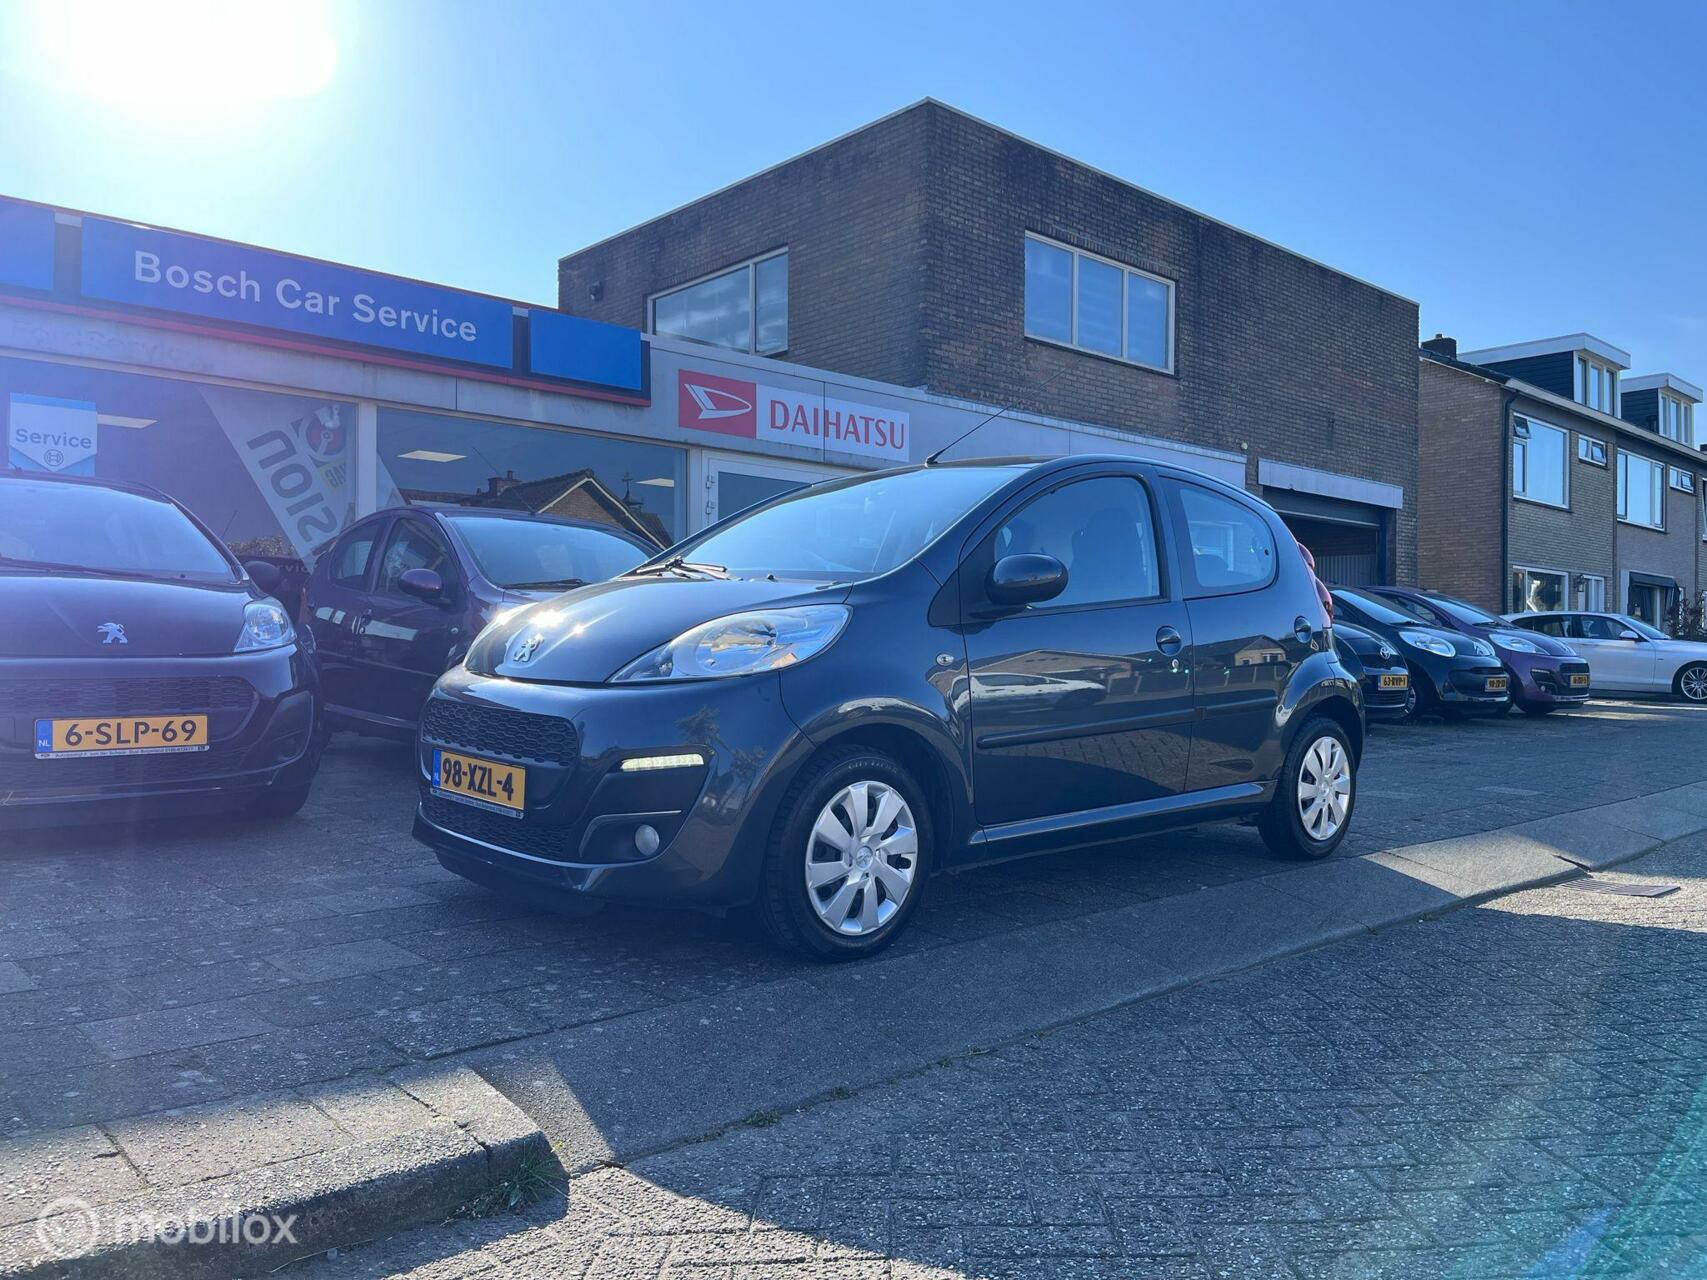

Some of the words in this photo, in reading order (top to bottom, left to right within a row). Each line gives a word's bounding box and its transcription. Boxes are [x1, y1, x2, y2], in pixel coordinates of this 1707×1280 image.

[133, 250, 261, 303] Bosch
[275, 278, 341, 317] Car
[351, 293, 478, 343] Service
[15, 427, 92, 450] Service
[770, 400, 905, 449] DAIHATSU
[38, 739, 50, 747] NL
[65, 719, 197, 747] 6-SLP-69
[442, 757, 514, 802] 98-XZL-4
